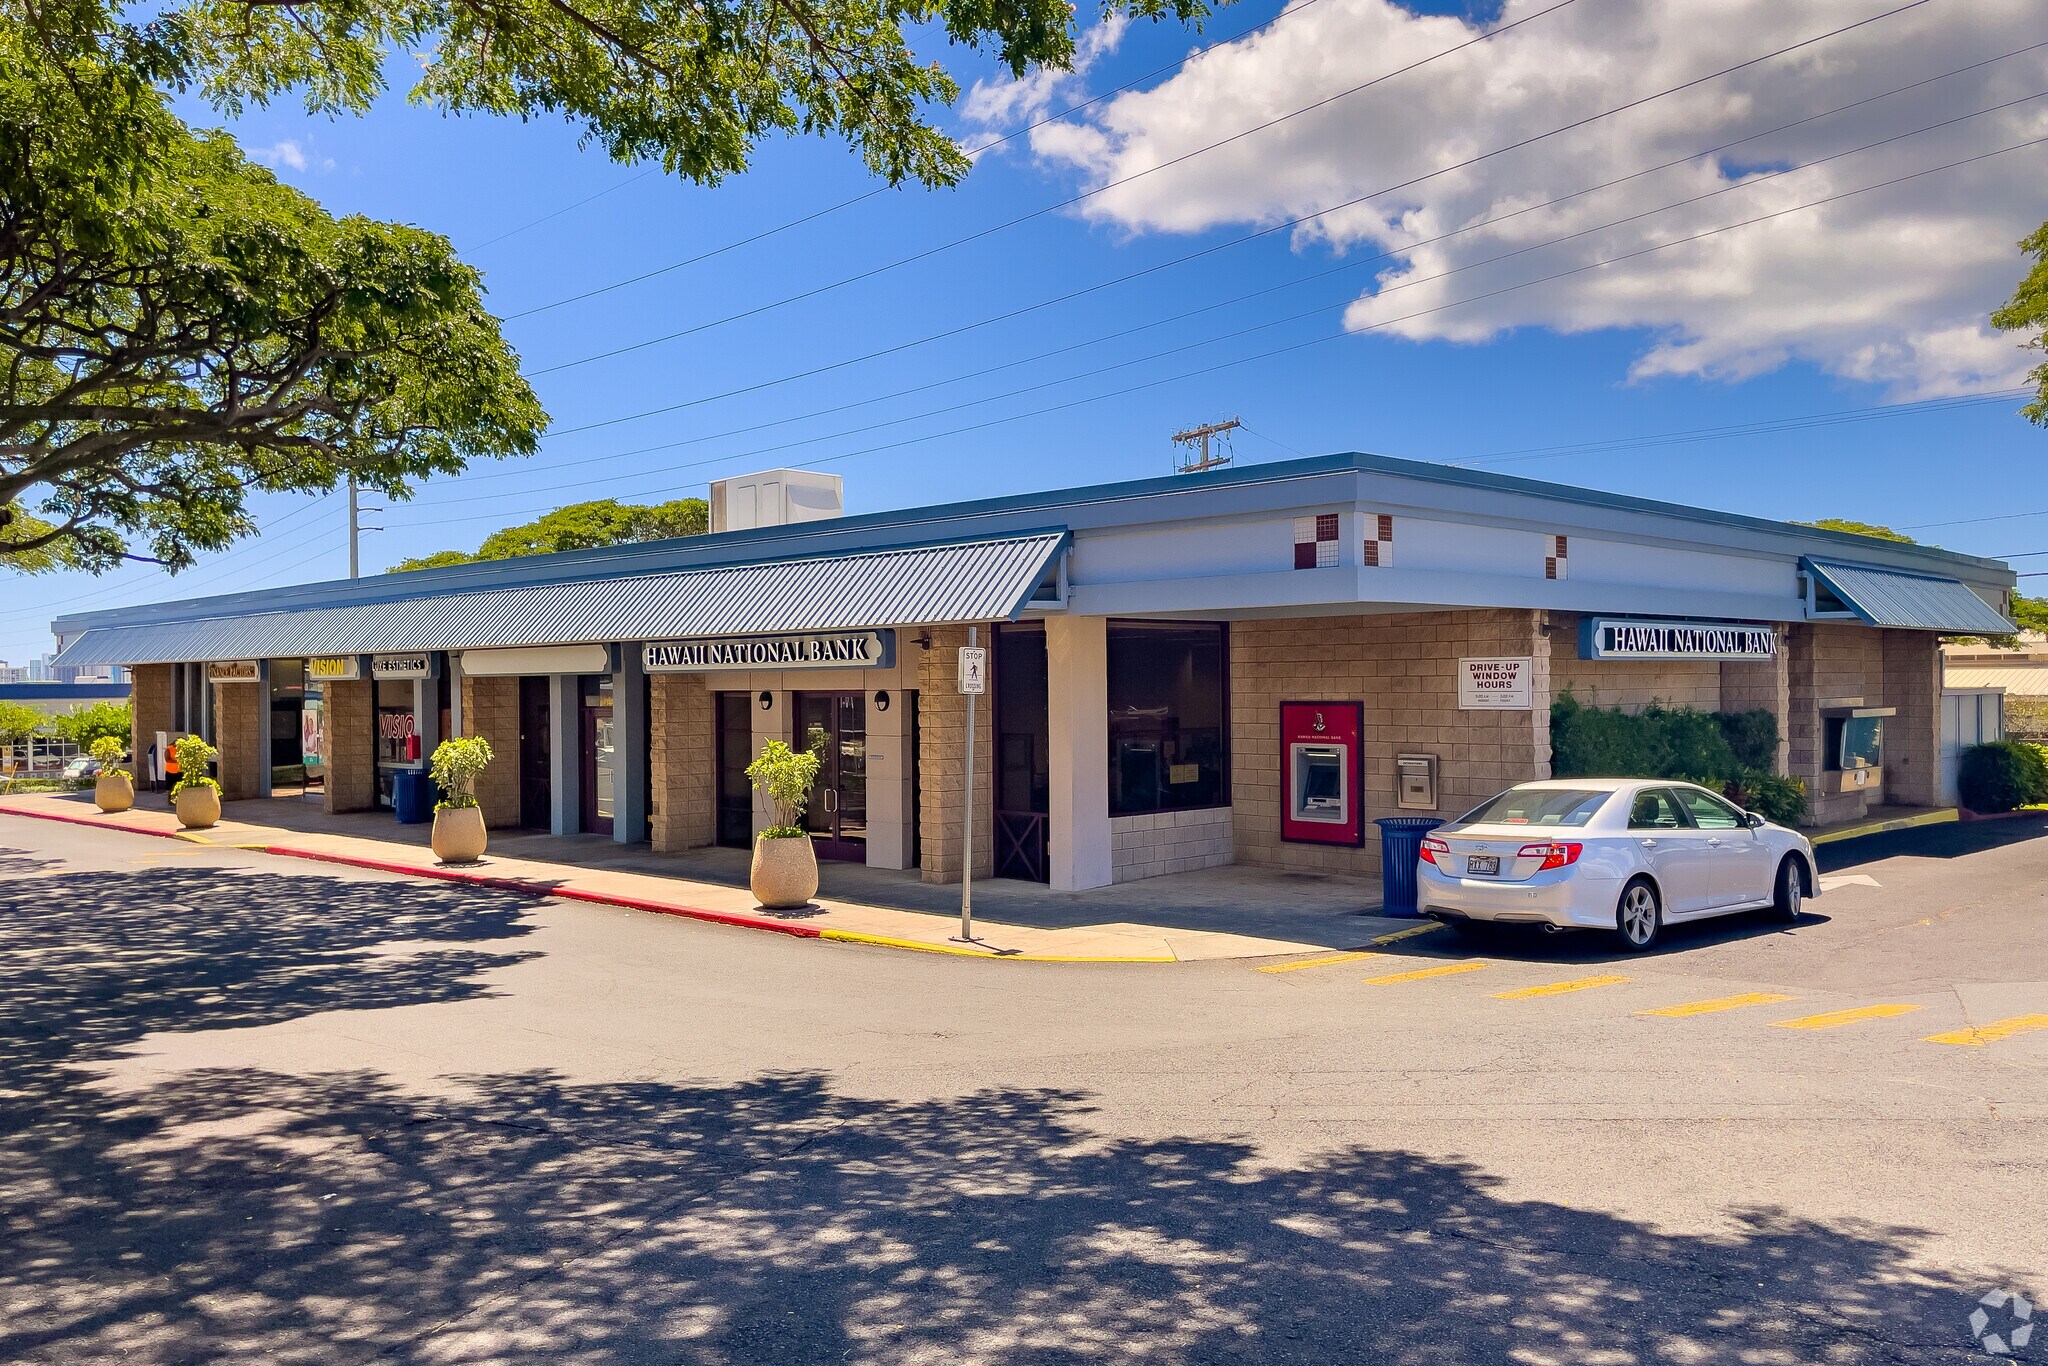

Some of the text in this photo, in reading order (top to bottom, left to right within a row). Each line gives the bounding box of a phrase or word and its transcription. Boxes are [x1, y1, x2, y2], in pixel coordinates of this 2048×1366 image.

[1613, 626, 1778, 655] HAWAII NATIONAL BANK
[646, 638, 868, 667] HAWAII NATIONAL BANK
[965, 652, 983, 660] STOP
[311, 658, 345, 676] VISION
[1469, 663, 1520, 672] DRIVE-UP
[1472, 672, 1517, 680] WINDOW
[1476, 681, 1513, 689] HOURS
